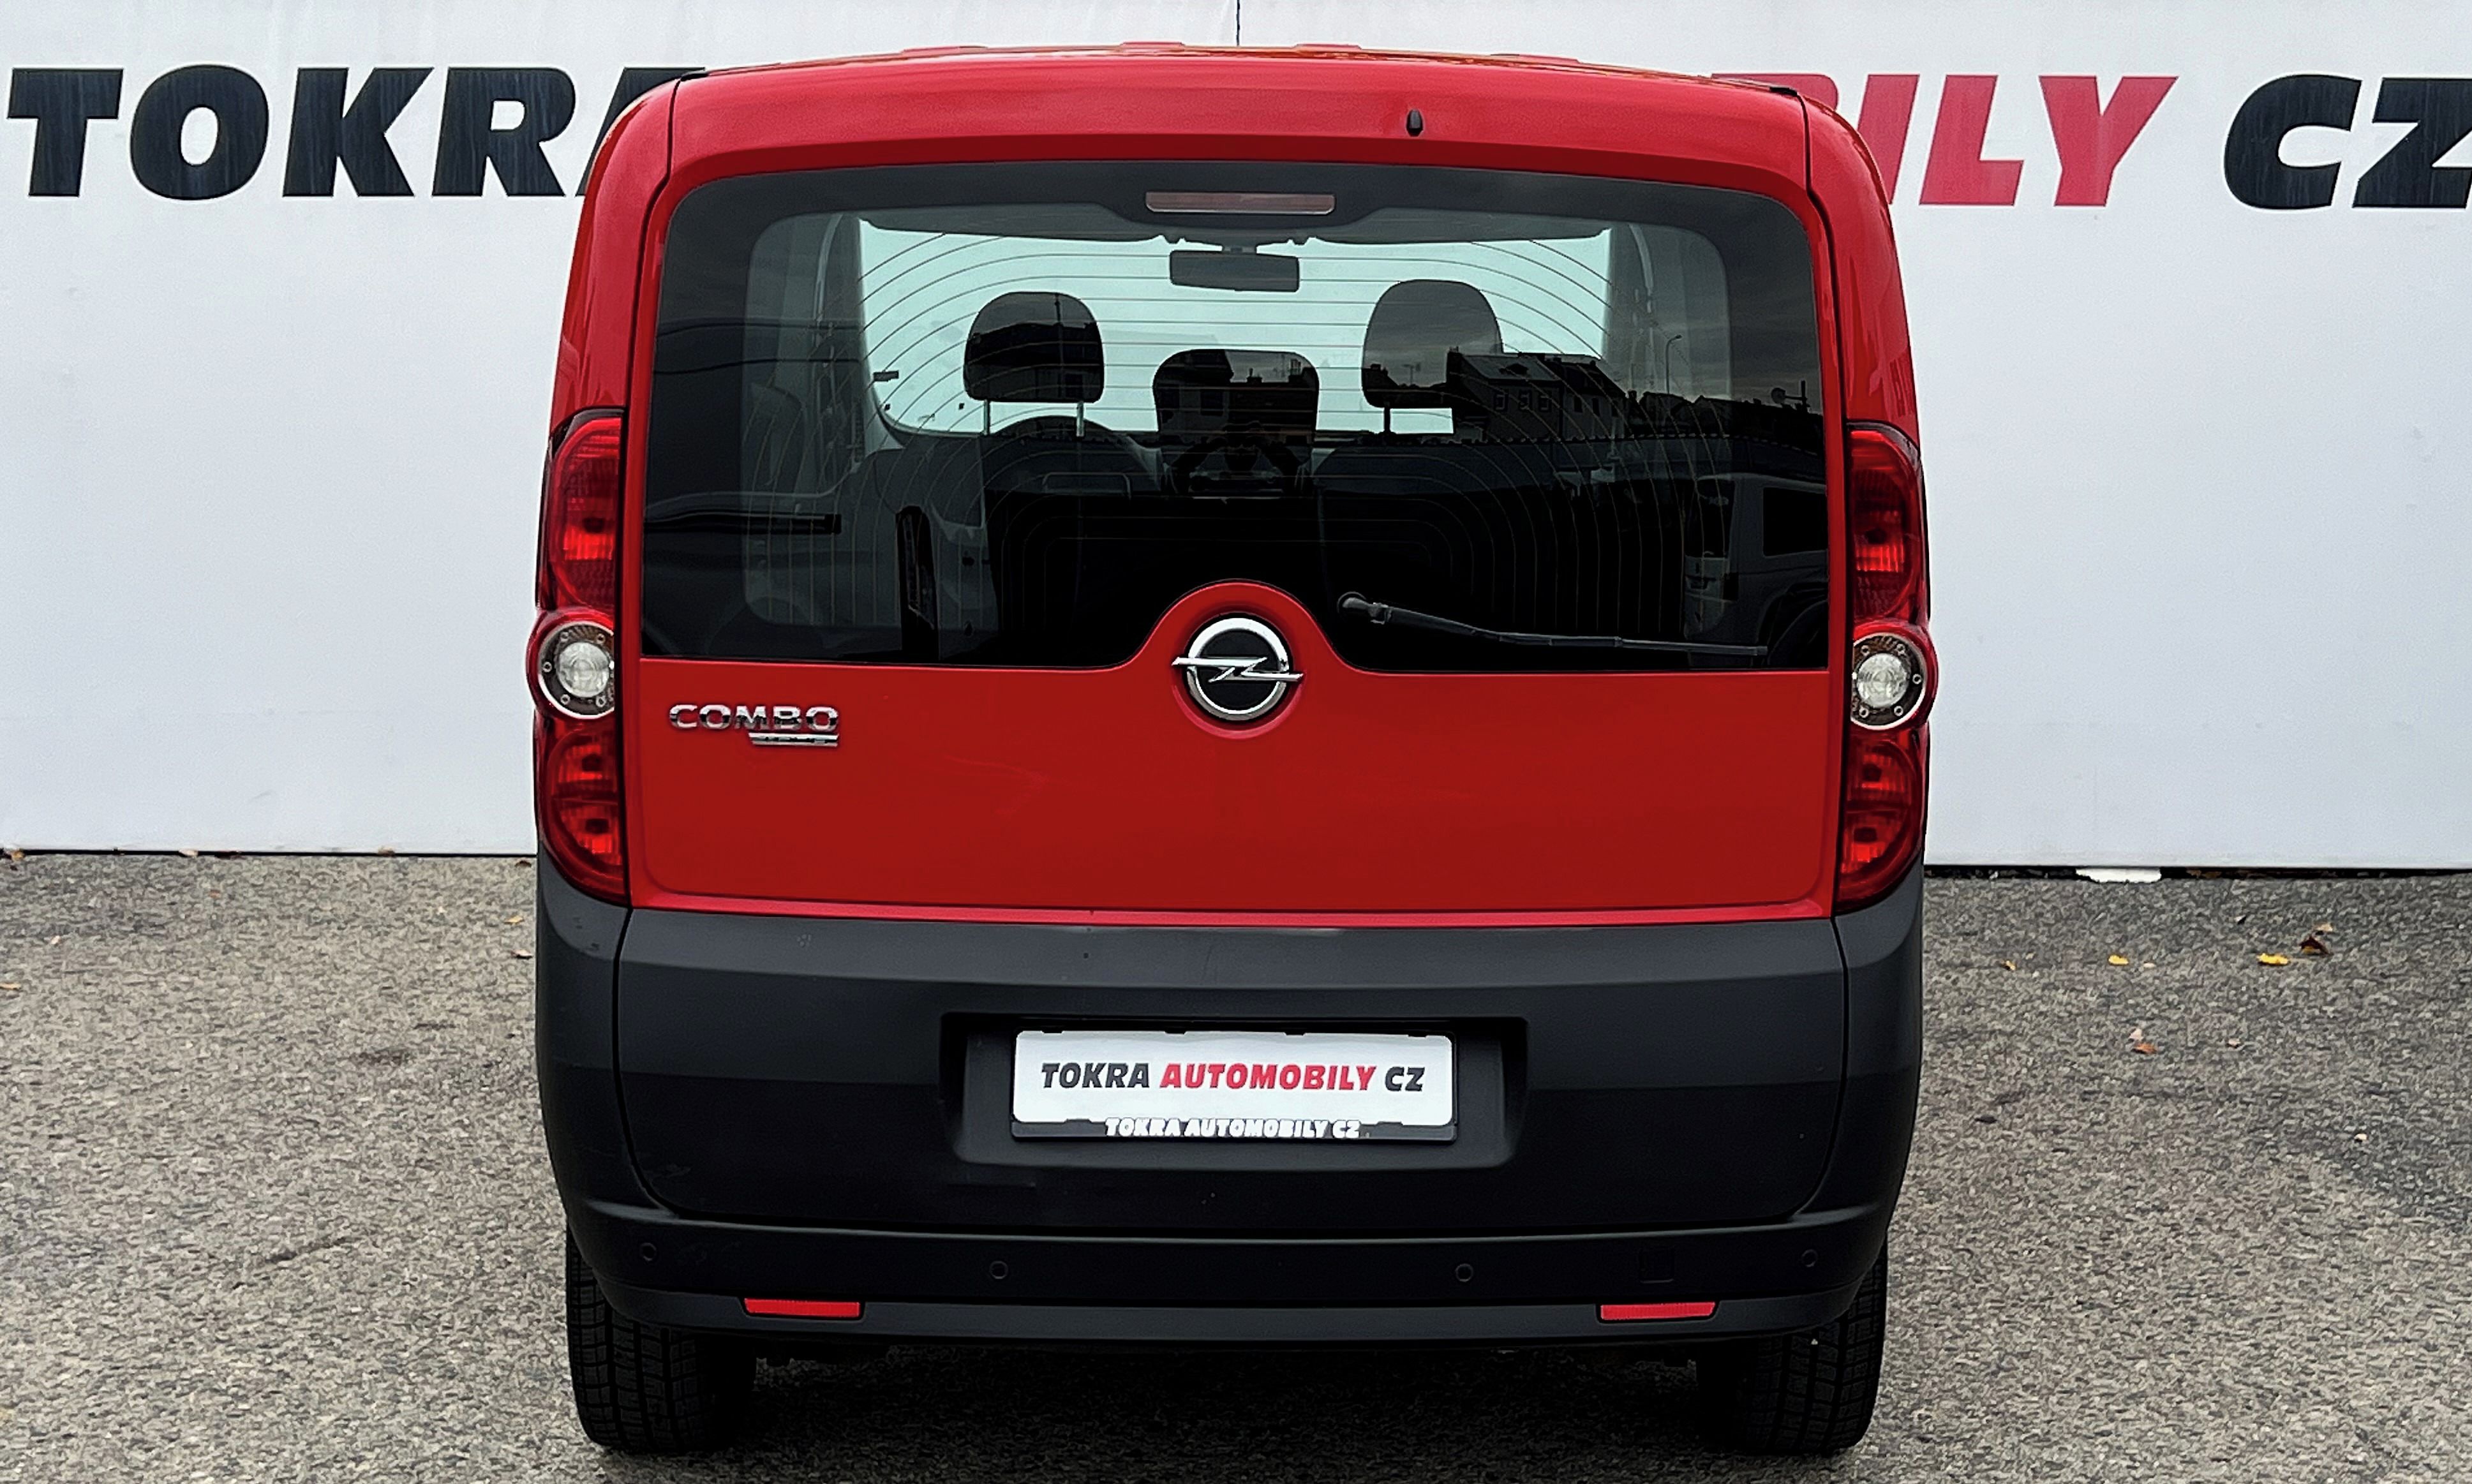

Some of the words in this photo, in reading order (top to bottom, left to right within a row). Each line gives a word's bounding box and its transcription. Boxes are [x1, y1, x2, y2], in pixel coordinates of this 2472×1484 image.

[1711, 73, 2178, 207] ILY
[2224, 73, 2472, 209] CZ
[669, 704, 838, 731] COMBO
[1041, 1062, 1149, 1088] TOKRA
[1160, 1064, 1376, 1090] AUTOMOBILY
[1385, 1066, 1425, 1092] CZ
[1105, 1117, 1184, 1138] TOKRA
[1184, 1118, 1330, 1139] AUTOMOBILY
[1332, 1119, 1362, 1139] CZ
